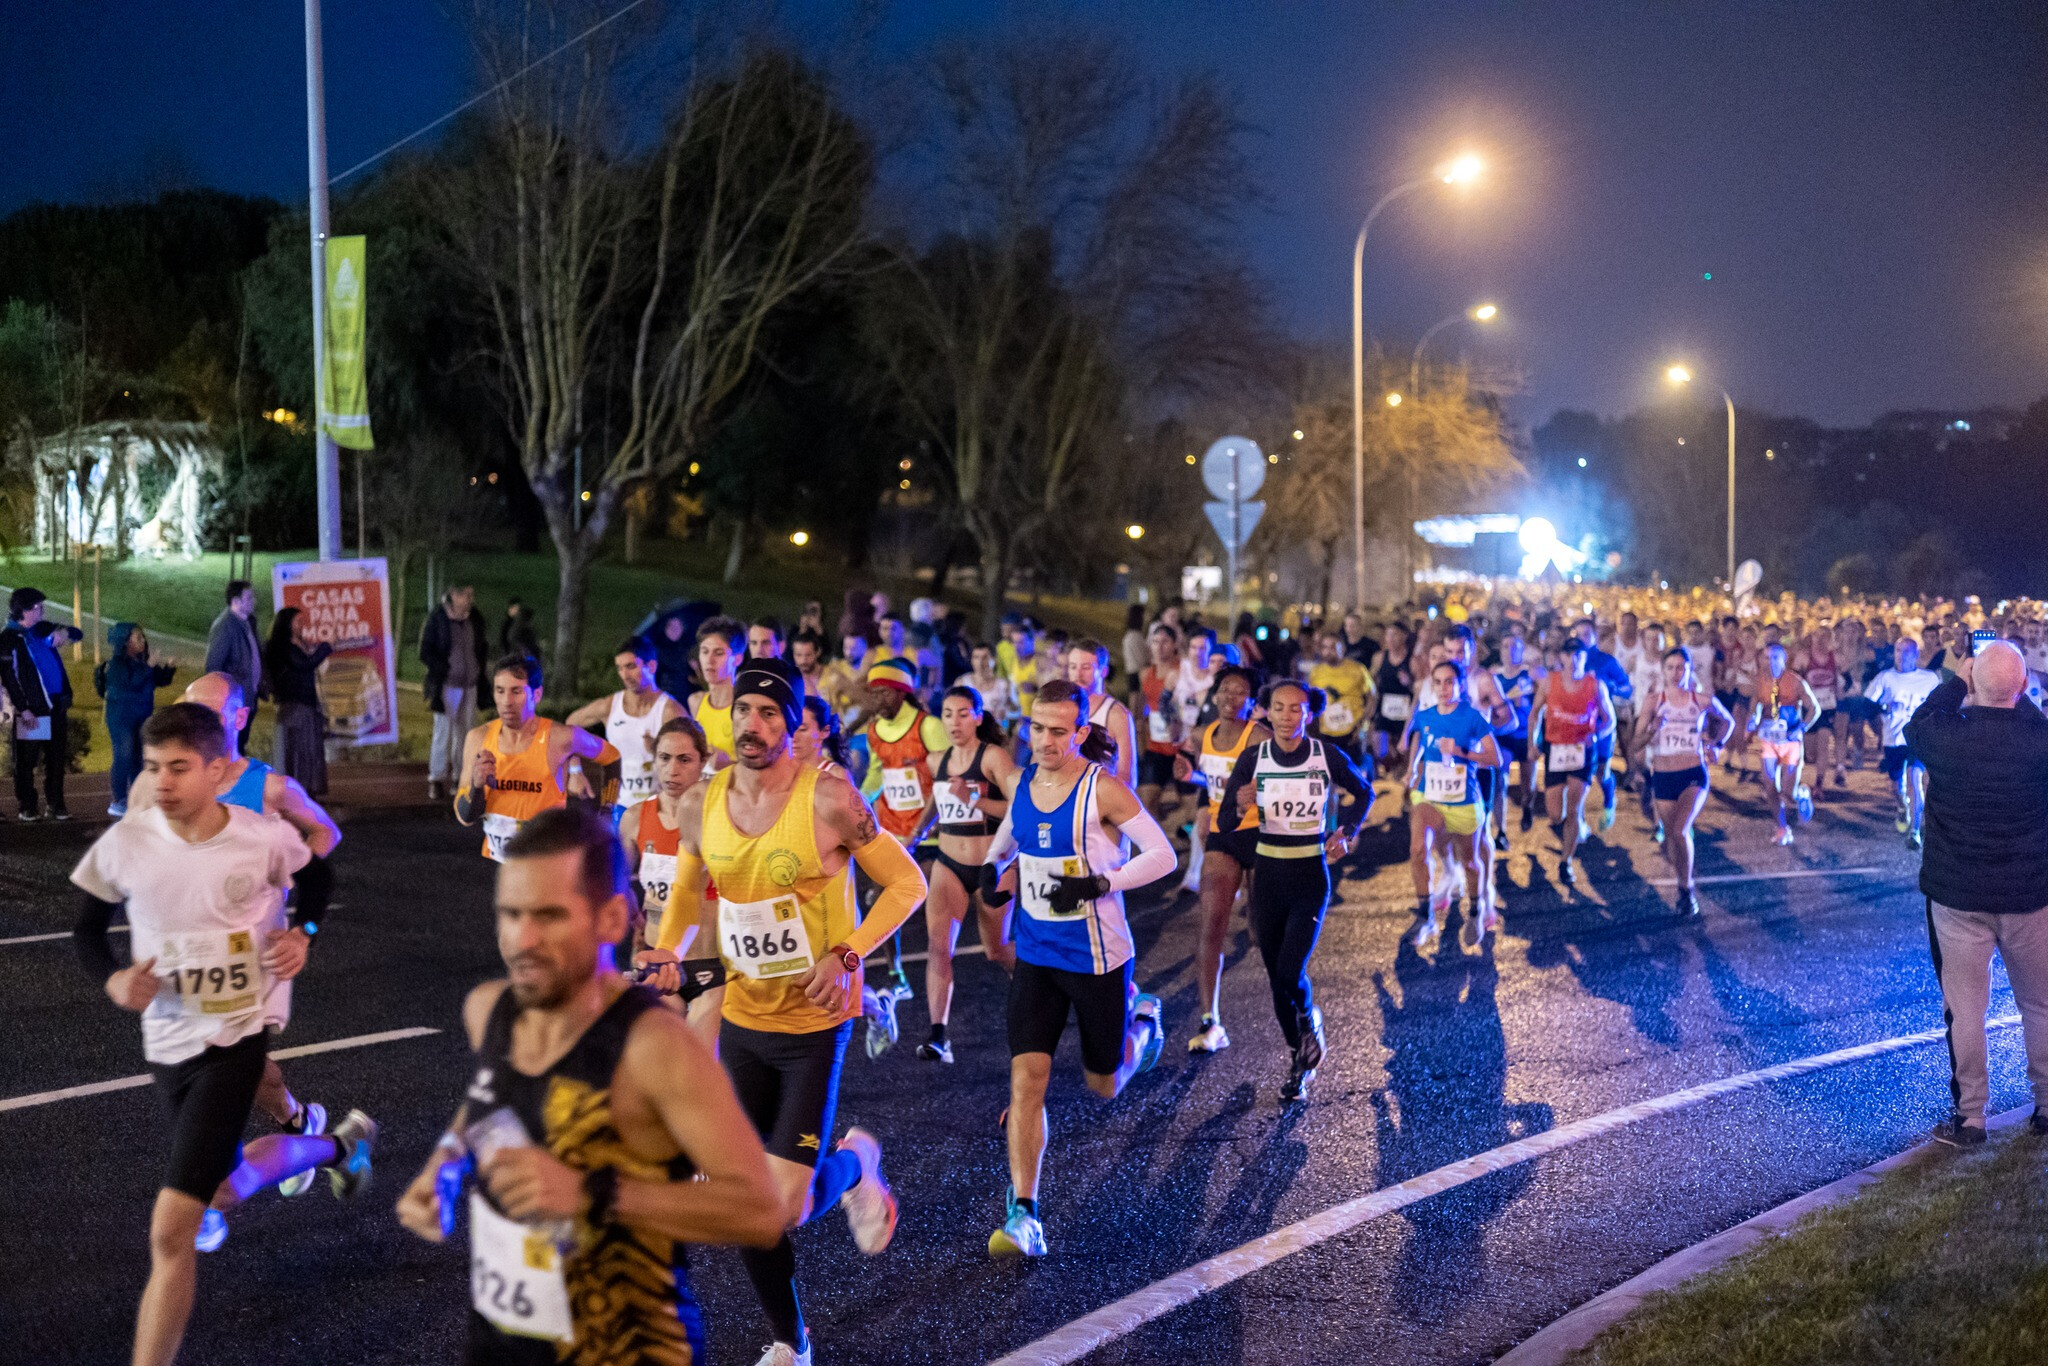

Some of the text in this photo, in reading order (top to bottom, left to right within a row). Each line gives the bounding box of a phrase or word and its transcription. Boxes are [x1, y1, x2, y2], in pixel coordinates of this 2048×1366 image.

[301, 586, 365, 608] CASAS
[309, 605, 360, 625] PARA
[1271, 801, 1318, 818] 1924
[729, 928, 798, 959] 1866
[168, 962, 249, 995] 1795
